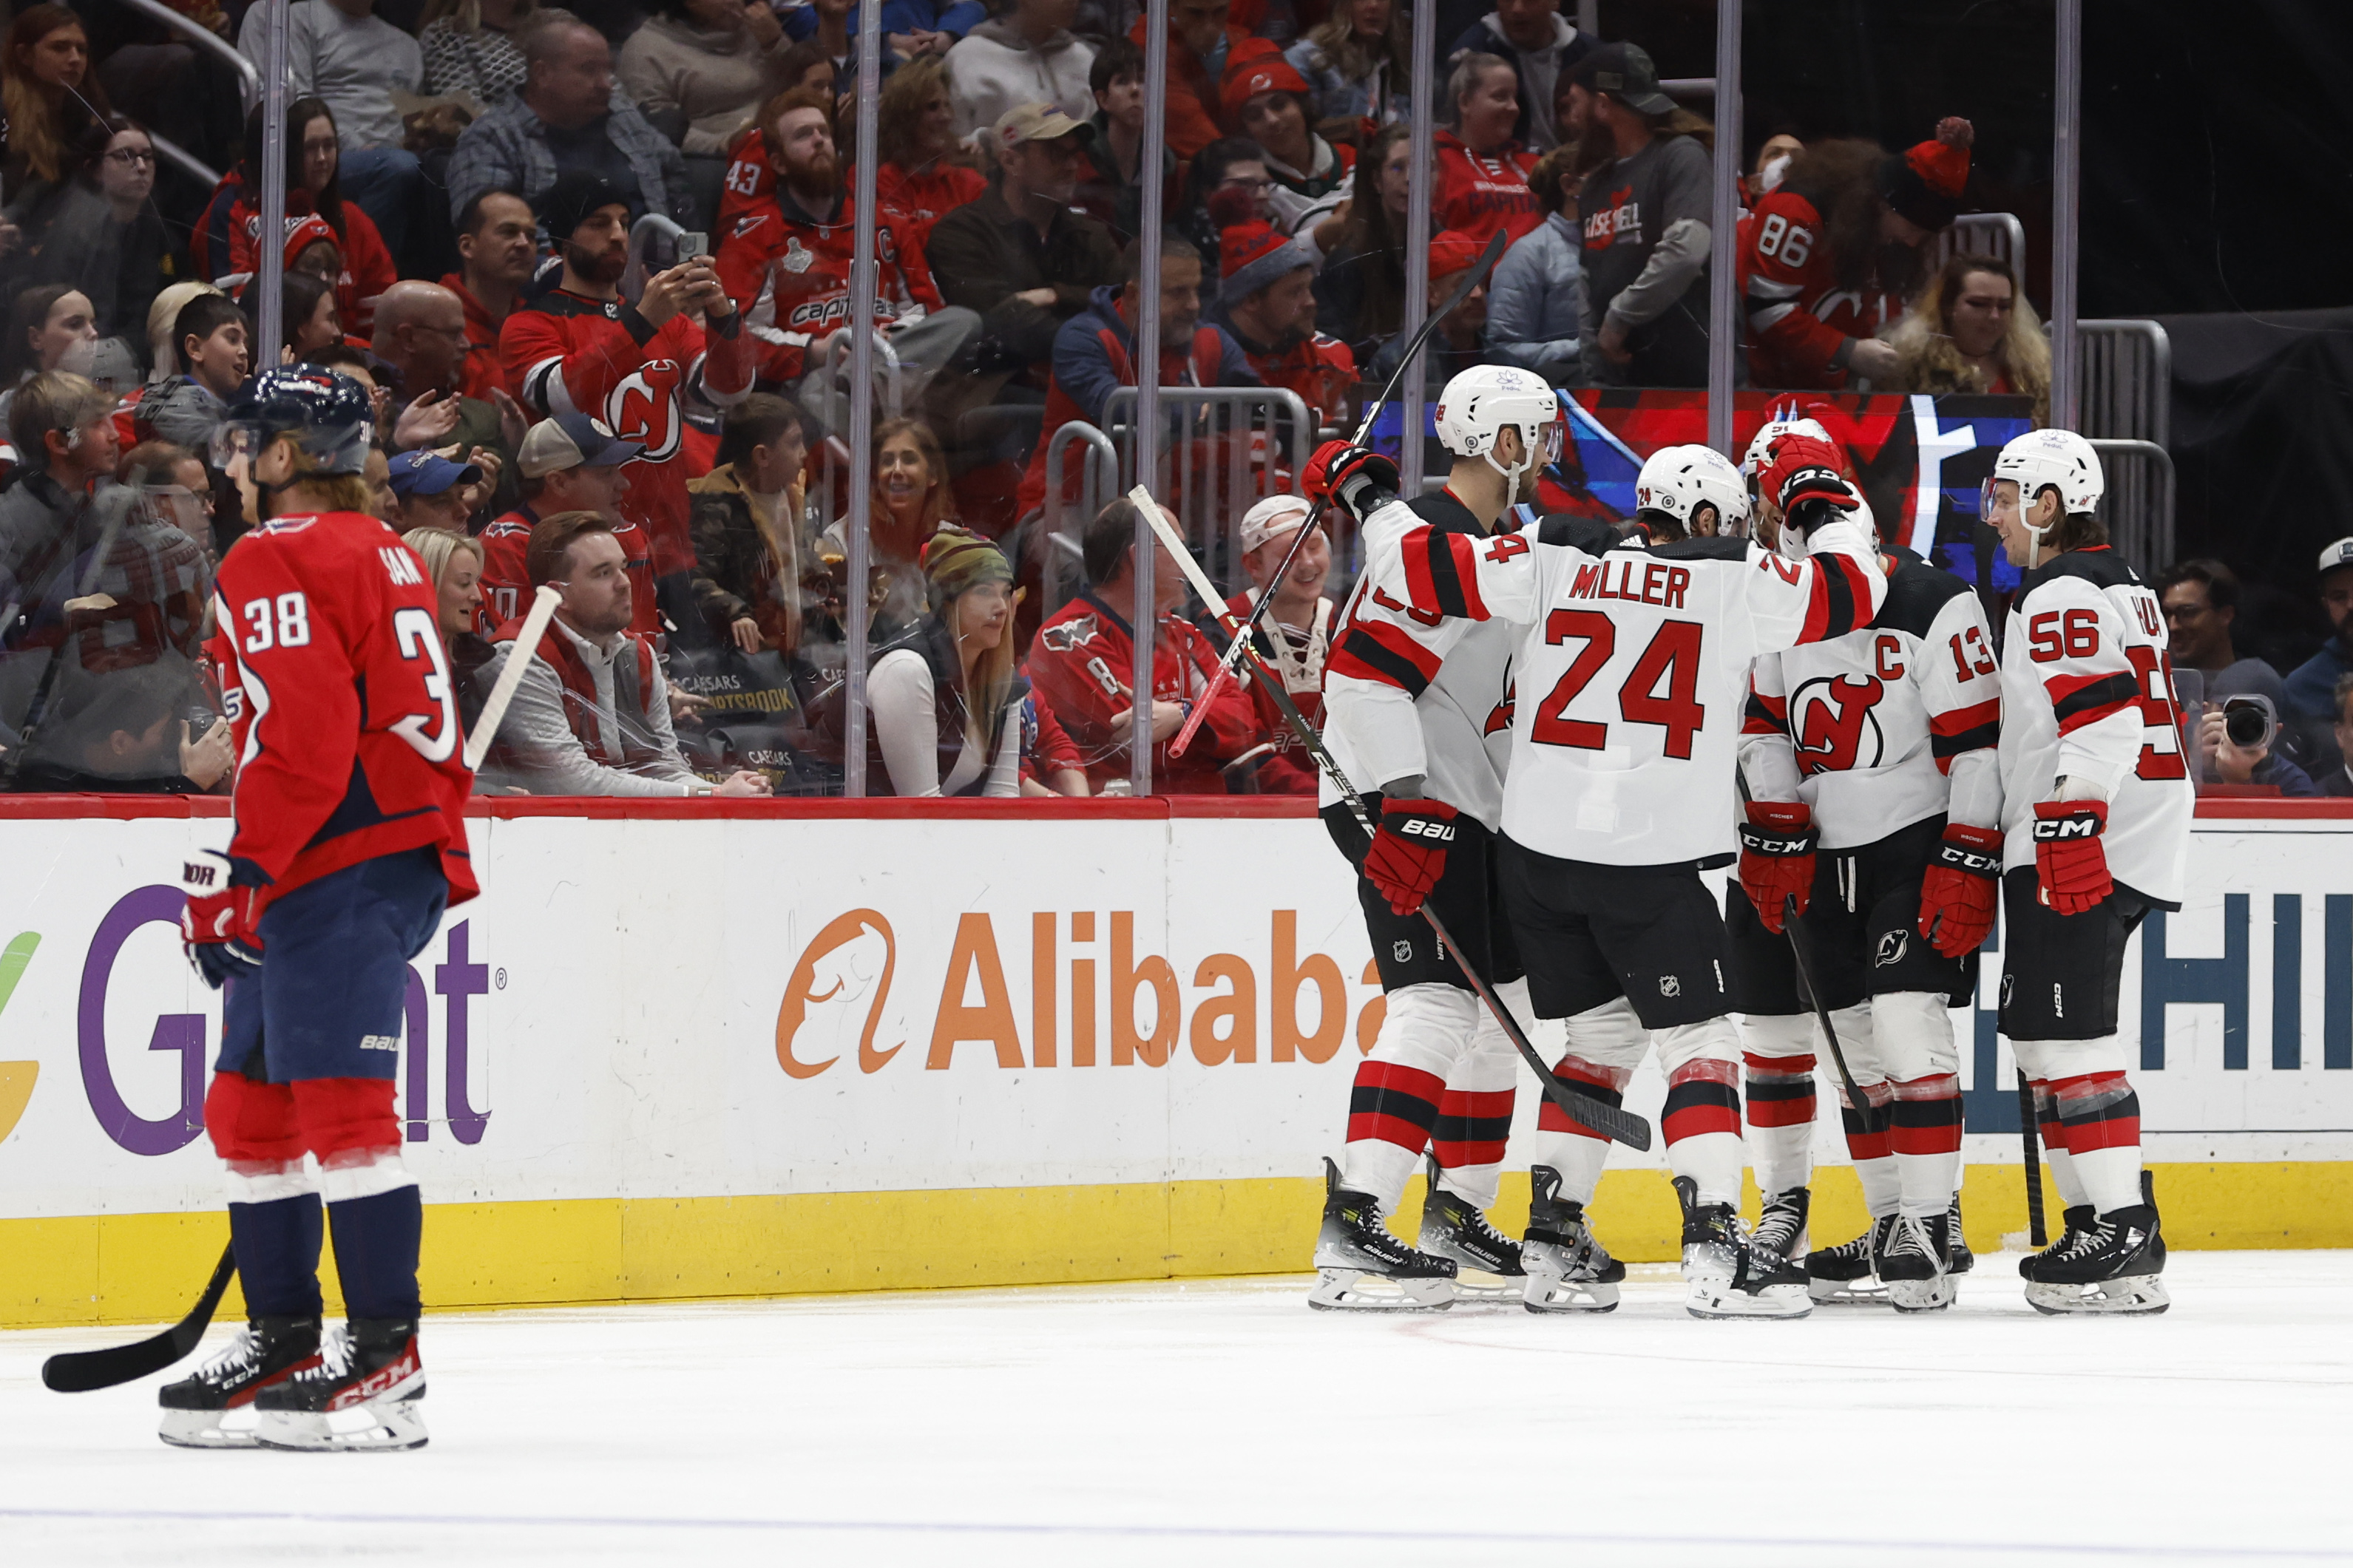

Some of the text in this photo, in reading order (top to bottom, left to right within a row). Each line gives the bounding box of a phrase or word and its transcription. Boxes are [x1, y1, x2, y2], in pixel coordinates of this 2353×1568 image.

[725, 160, 761, 196] 43
[1758, 213, 1814, 268] 86
[1638, 486, 1651, 506] 24
[1777, 469, 1841, 509] CCM
[486, 587, 518, 621] 0
[1568, 560, 1691, 610] MILLER
[244, 591, 311, 654] 38
[2029, 608, 2099, 663] 56
[1875, 634, 1906, 681] C
[1949, 625, 1997, 684] 13
[394, 606, 478, 770] 3
[681, 674, 741, 693] CAESARS
[821, 667, 847, 683] CAES
[1086, 656, 1120, 696] 8
[1530, 608, 1704, 761] 24
[2124, 644, 2192, 781] 5
[748, 749, 793, 767] CAESARS
[1743, 832, 1809, 854] CCM
[2034, 818, 2095, 838] CM
[1941, 846, 2002, 872] CCM
[2054, 982, 2064, 1019] CCM
[78, 883, 492, 1157] Gnt
[1362, 1243, 1404, 1265] BAUER
[1463, 1241, 1503, 1265] BAUER
[223, 1364, 260, 1391] CCM
[333, 1356, 413, 1411] CCM
